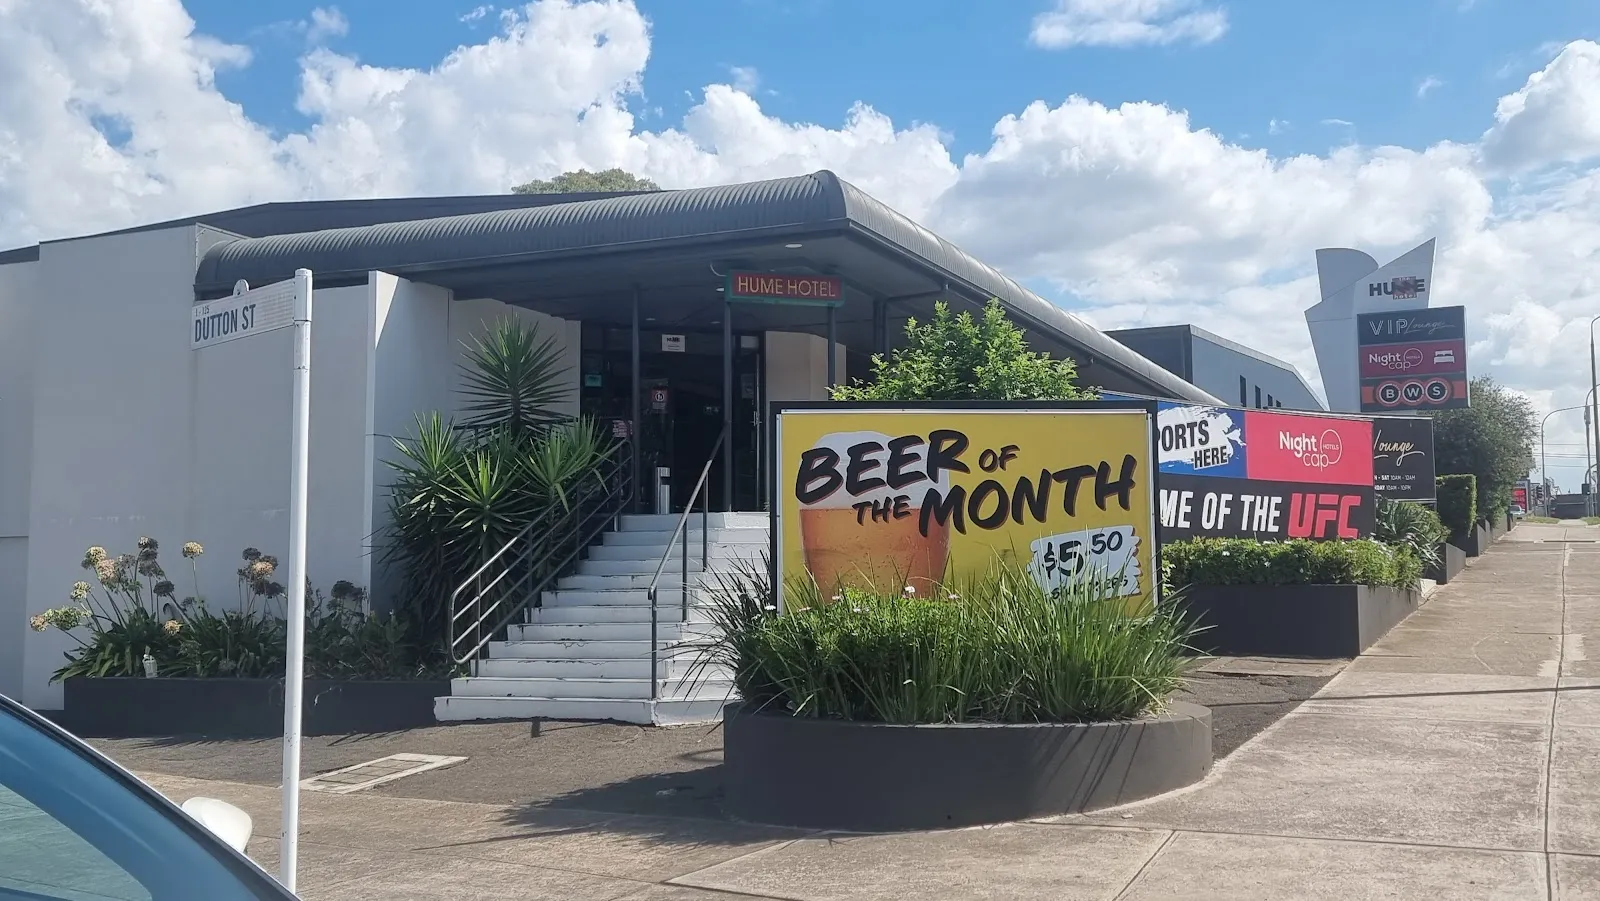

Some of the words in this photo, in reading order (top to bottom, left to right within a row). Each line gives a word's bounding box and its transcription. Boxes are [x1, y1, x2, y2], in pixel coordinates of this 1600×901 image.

[738, 276, 783, 294] HUME
[787, 280, 836, 297] HOTEL
[1369, 279, 1426, 296] HUE
[195, 309, 238, 342] DUTTON
[242, 304, 257, 330] ST
[1369, 318, 1408, 336] VIP
[1369, 353, 1401, 366] Night
[1388, 361, 1412, 371] cap
[1157, 420, 1210, 452] ORTS
[1279, 430, 1318, 458] Night
[795, 429, 971, 506] BEER
[978, 444, 1021, 473] OF
[1194, 446, 1228, 468] HERE
[1303, 453, 1330, 472] cap
[852, 495, 912, 526] THE
[918, 454, 1138, 537] MONTH
[1160, 489, 1194, 529] ME
[1202, 492, 1233, 530] OF
[1240, 495, 1282, 533] THE
[1288, 493, 1361, 539] UFC
